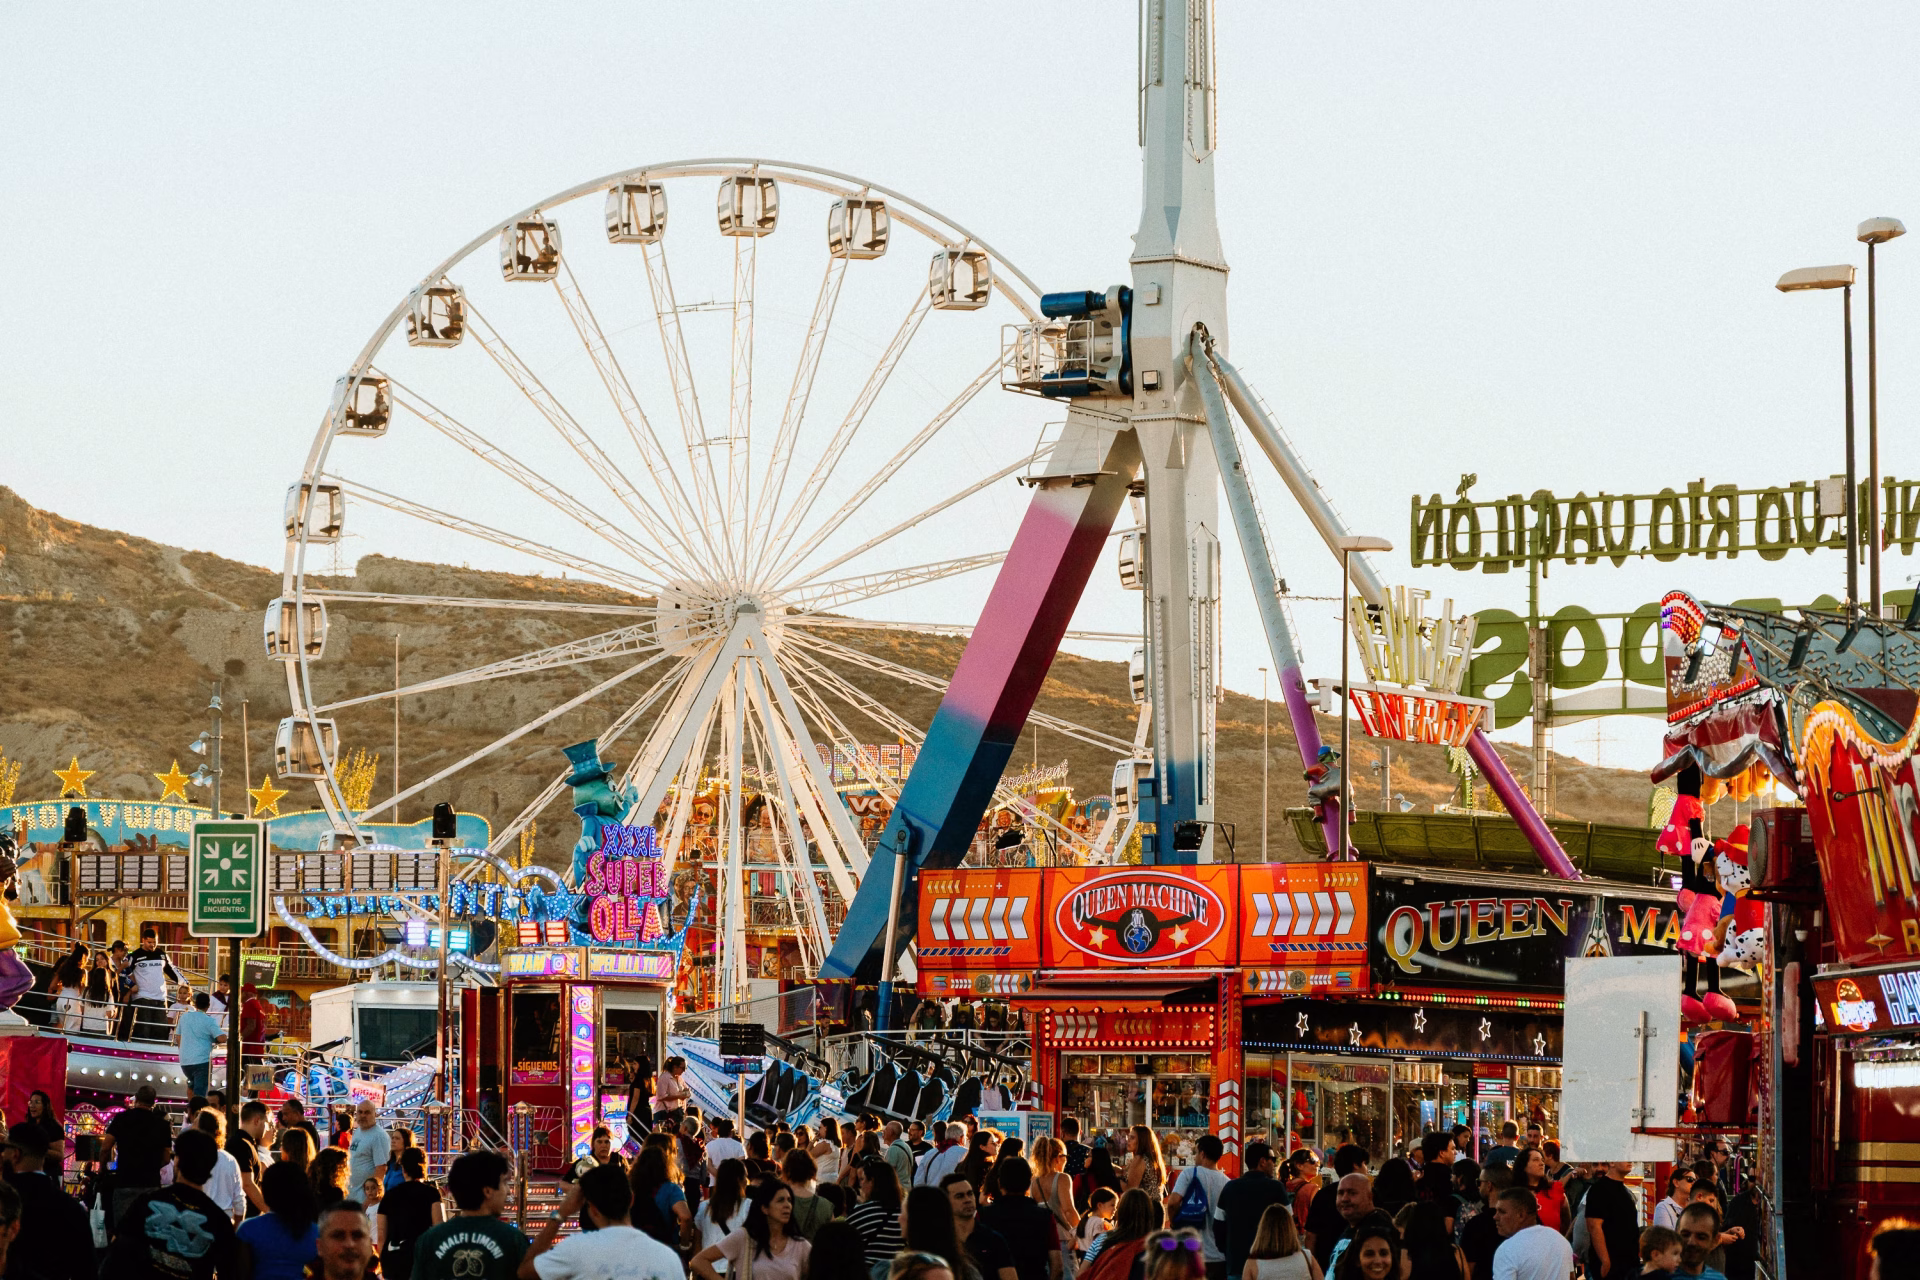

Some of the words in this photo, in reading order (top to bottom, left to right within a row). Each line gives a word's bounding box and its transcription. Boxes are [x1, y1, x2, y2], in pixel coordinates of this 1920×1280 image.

[1350, 688, 1487, 747] ENERGY
[602, 824, 664, 858] XXXL
[586, 851, 669, 898] SUPER
[203, 905, 246, 913] ENCUENTRO
[207, 897, 231, 905] PUNTO
[232, 897, 242, 905] DE
[1072, 884, 1128, 930] QUEEN
[1131, 883, 1209, 927] MACHINE
[590, 895, 664, 943] OLLA
[1384, 897, 1574, 974] QUEEN
[252, 1072, 270, 1084] XXXL
[517, 1057, 558, 1071] SÍGUENOS
[435, 1232, 468, 1259] AMALFI
[471, 1232, 504, 1259] LIMONI
